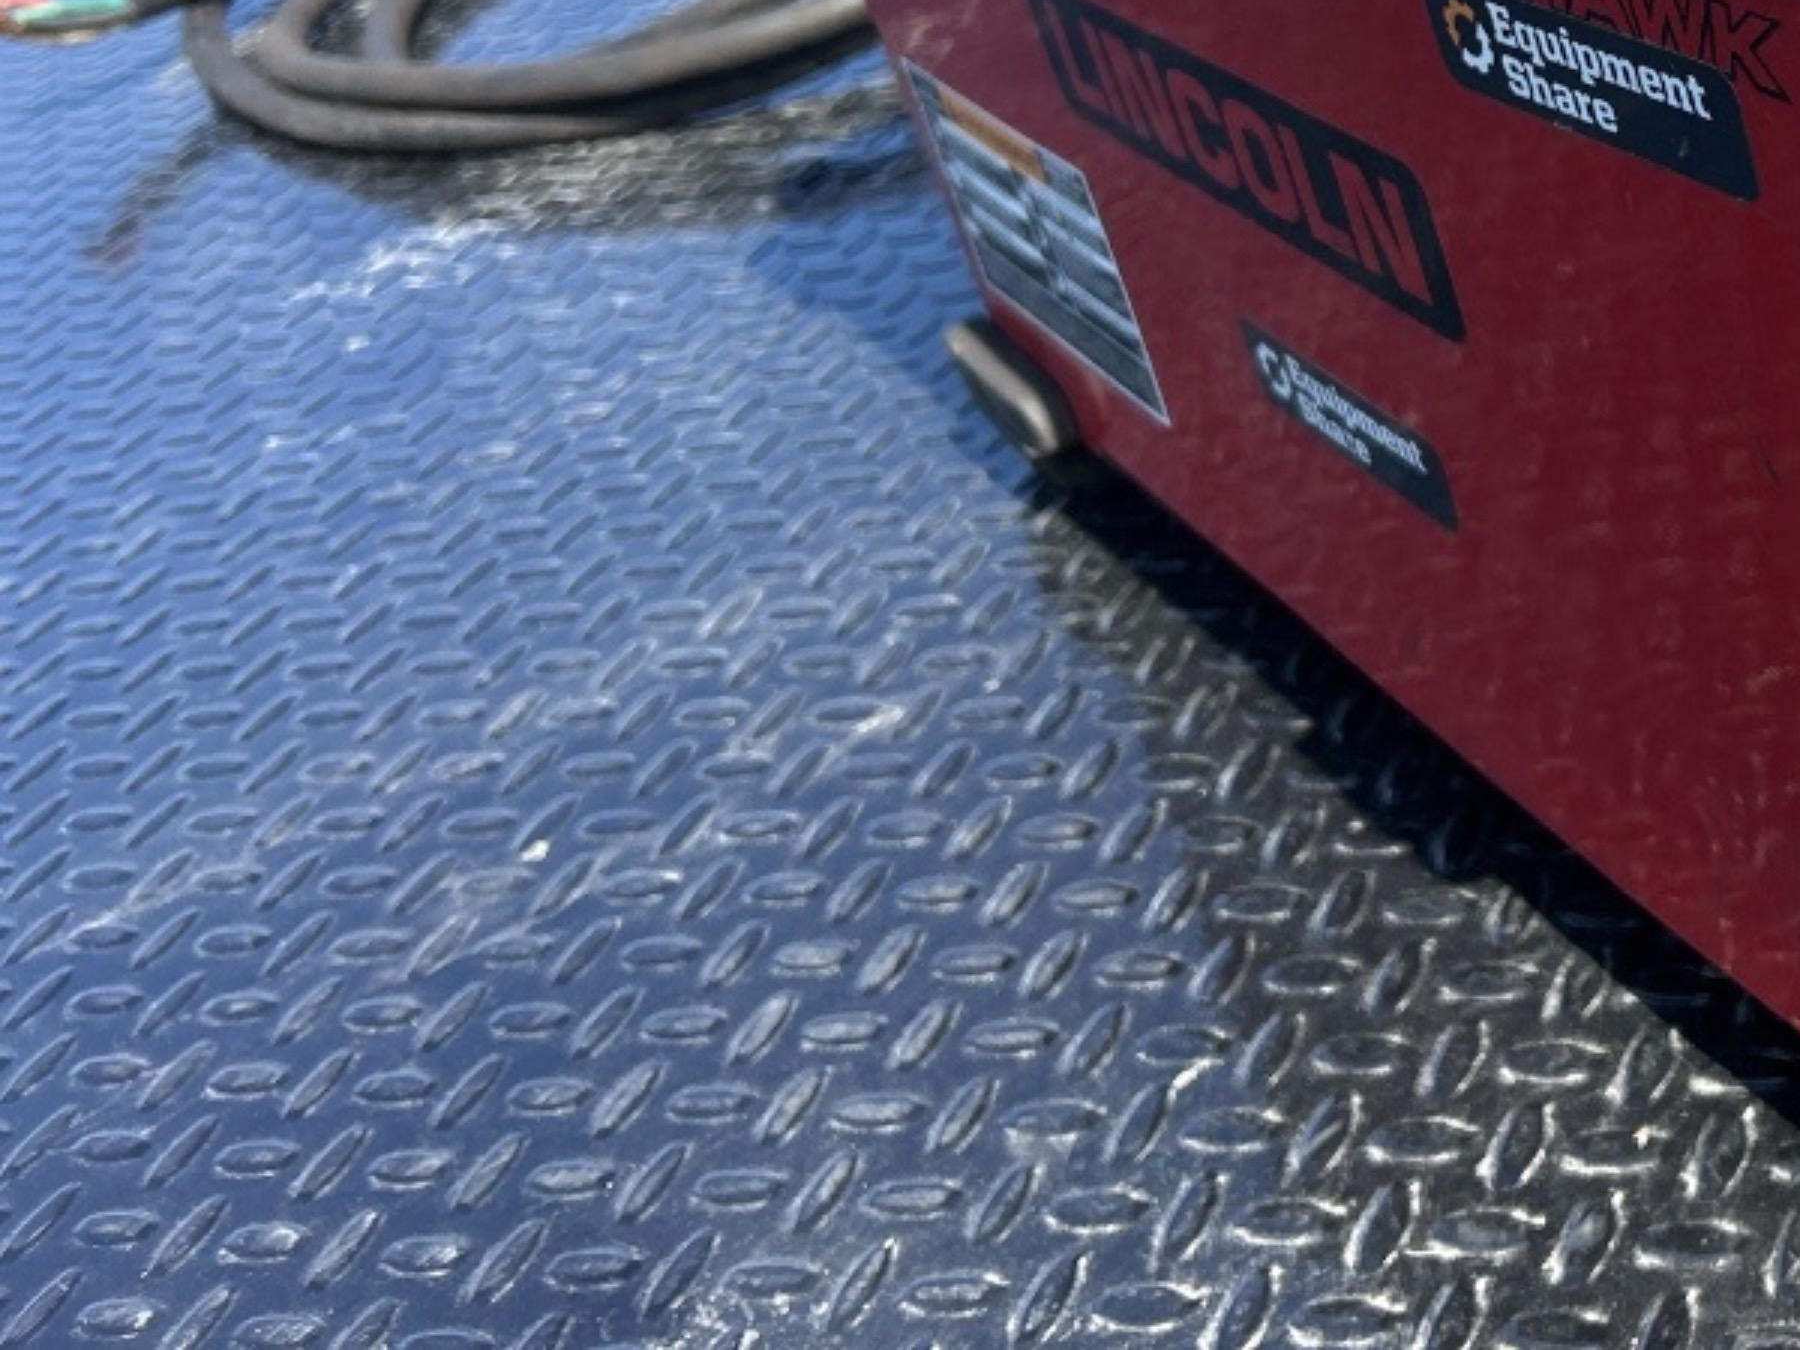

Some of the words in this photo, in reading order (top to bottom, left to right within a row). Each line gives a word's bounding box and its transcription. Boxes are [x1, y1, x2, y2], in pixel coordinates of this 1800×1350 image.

[1484, 1, 1713, 121] Equipment
[1502, 56, 1618, 134] Share
[1288, 355, 1428, 476] Equipment
[1298, 396, 1373, 468] Share
